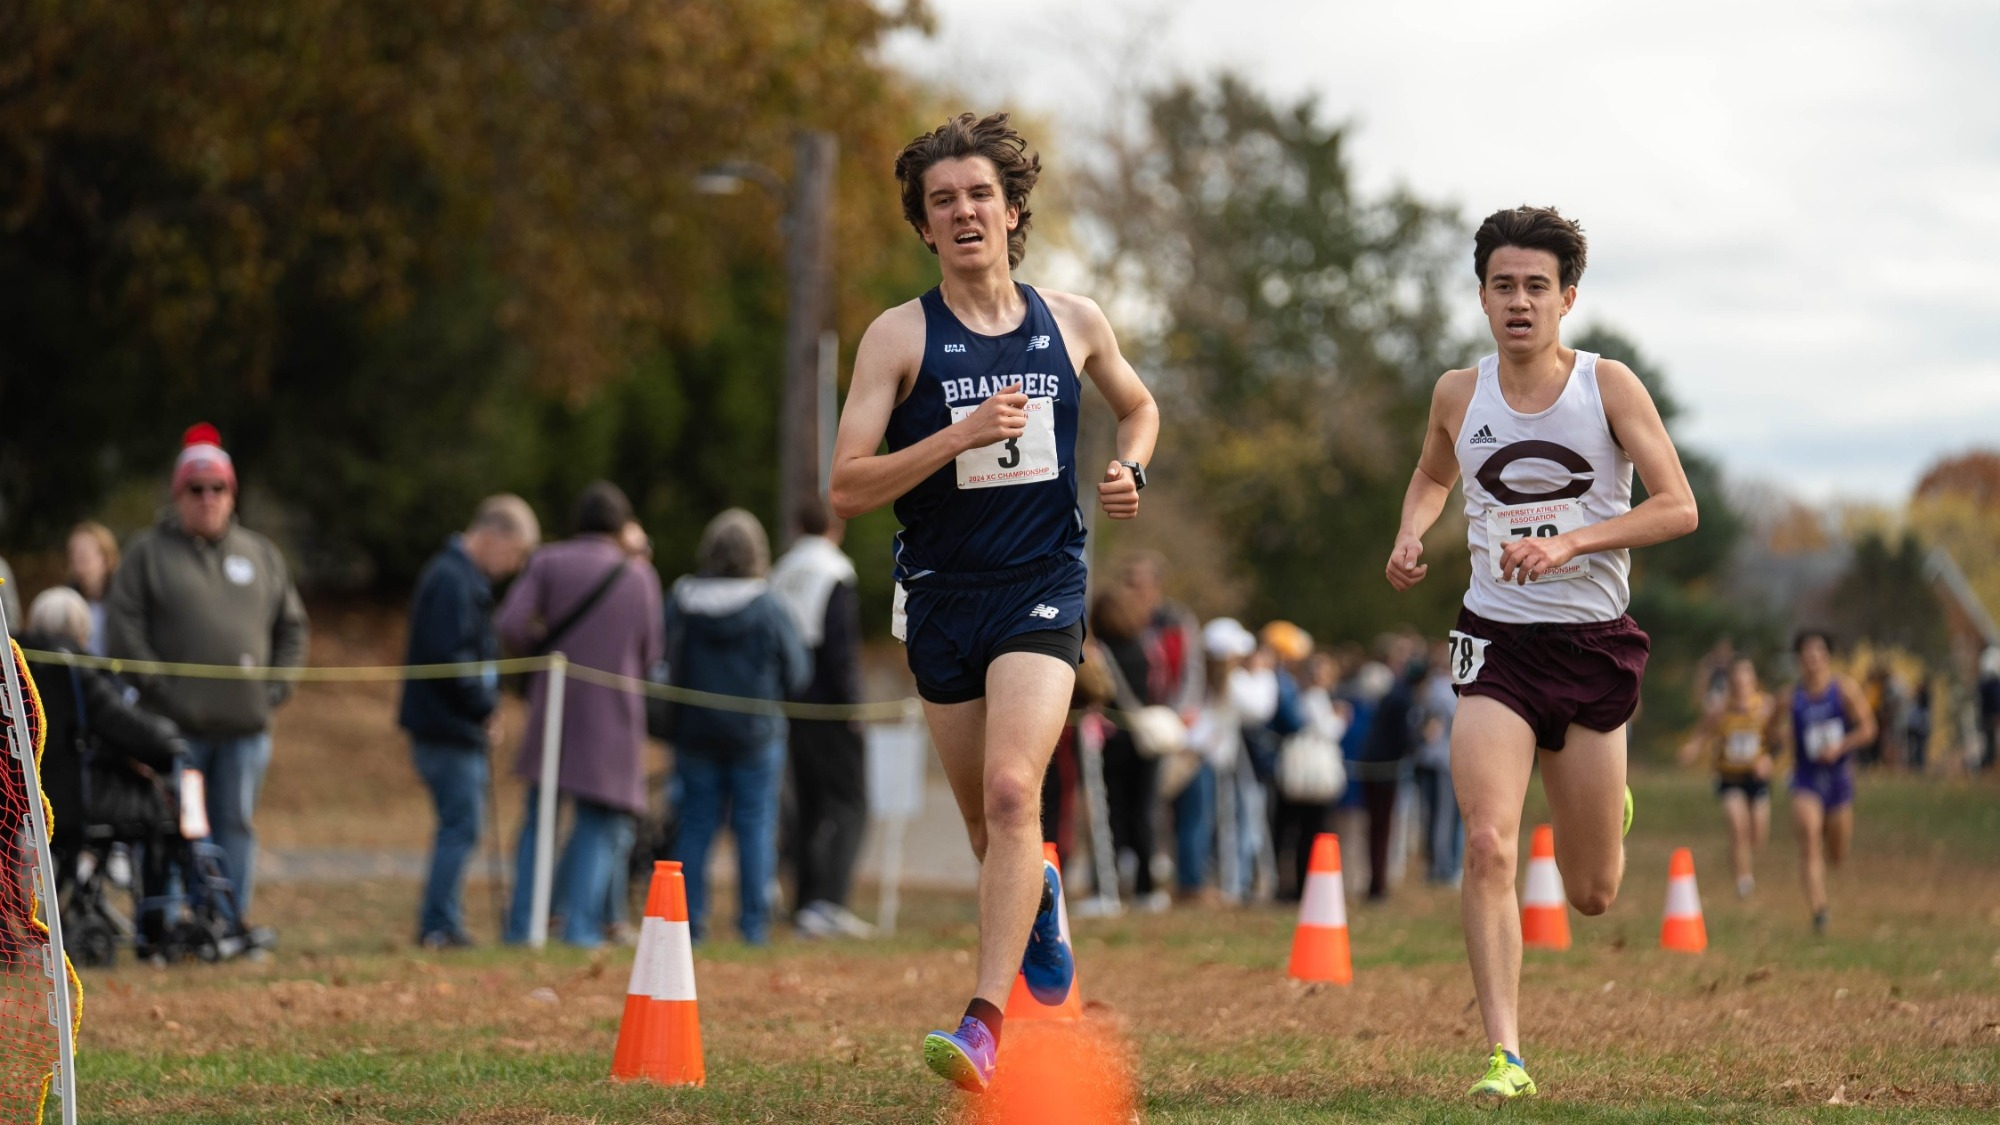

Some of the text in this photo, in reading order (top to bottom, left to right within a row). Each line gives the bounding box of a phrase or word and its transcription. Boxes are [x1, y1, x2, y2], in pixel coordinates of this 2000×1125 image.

[944, 343, 967, 353] UAA
[942, 373, 1060, 403] BRANDEIS
[1469, 436, 1497, 444] adidas
[997, 437, 1020, 469] 3
[968, 475, 985, 483] 2024
[998, 467, 1050, 480] CHAMPIONSHIP
[1474, 439, 1595, 505] C
[1497, 503, 1570, 518] UNIVERSITY ATHLETIC
[1510, 513, 1557, 524] ASSOCIATION
[1530, 564, 1581, 576] MPIONSHIP
[1449, 636, 1474, 679] 78
